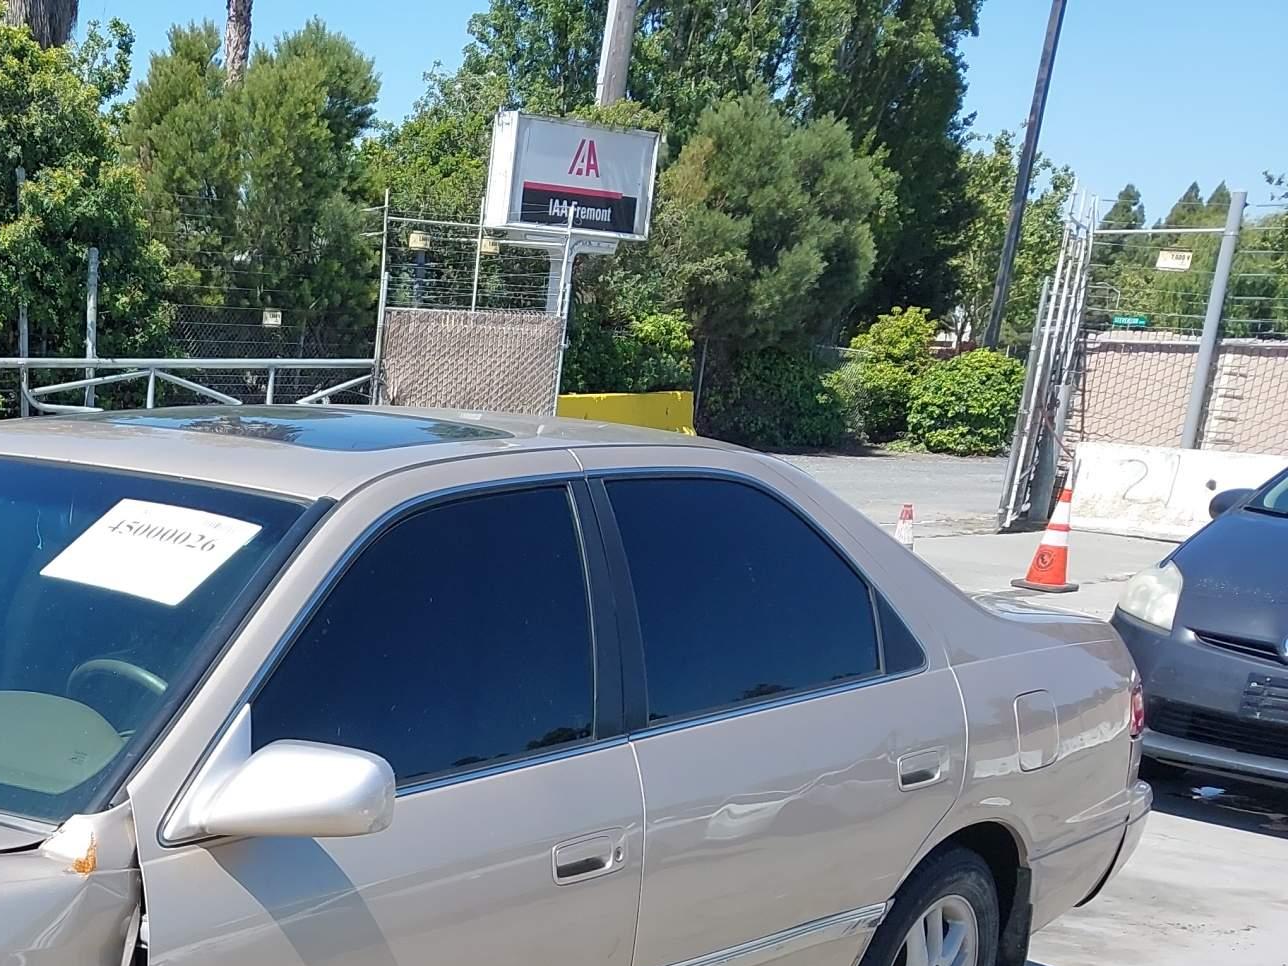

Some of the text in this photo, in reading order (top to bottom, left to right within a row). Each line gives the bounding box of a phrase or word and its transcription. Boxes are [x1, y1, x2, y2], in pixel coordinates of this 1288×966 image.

[548, 198, 612, 222] IAA Fremont
[108, 519, 216, 552] 45000026
